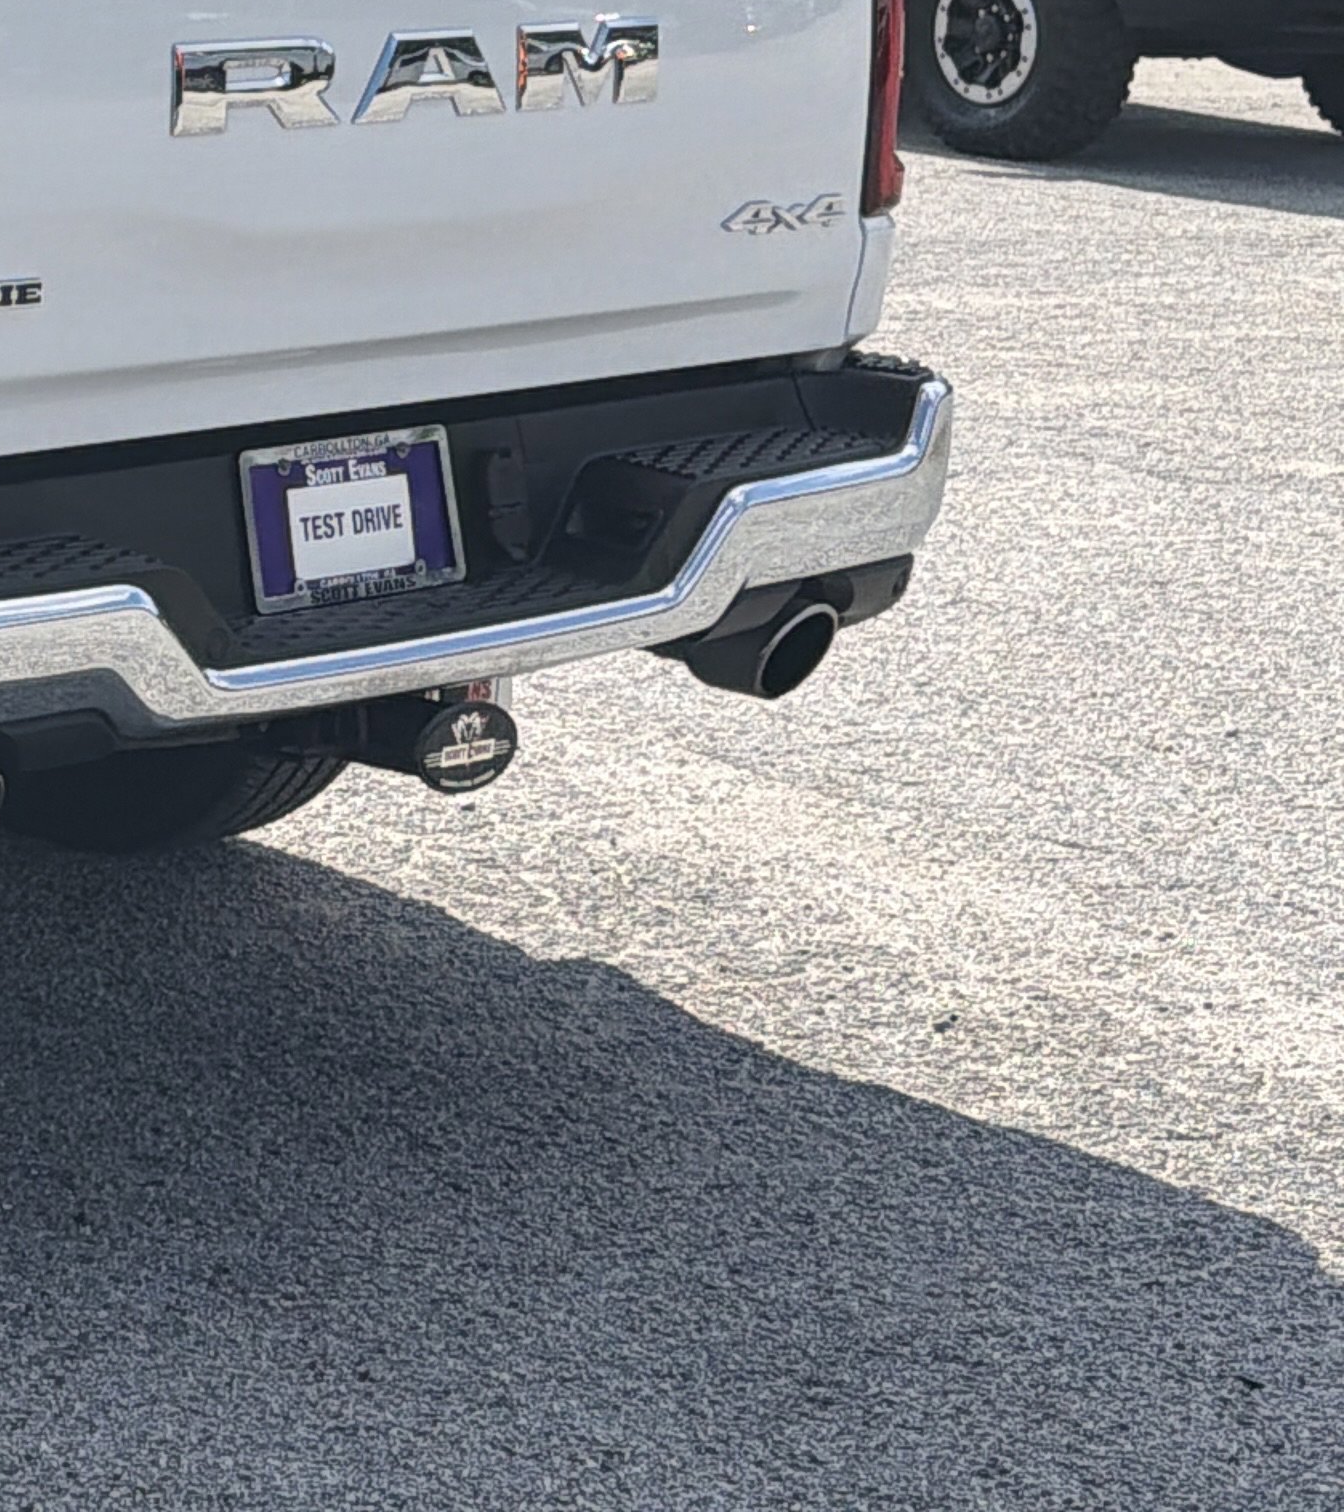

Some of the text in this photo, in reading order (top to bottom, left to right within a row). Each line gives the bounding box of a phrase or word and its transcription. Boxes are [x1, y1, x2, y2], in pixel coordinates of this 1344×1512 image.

[170, 14, 659, 137] RAM
[299, 504, 403, 541] TEST DRIVE
[310, 576, 416, 604] SCOTT EVANS
